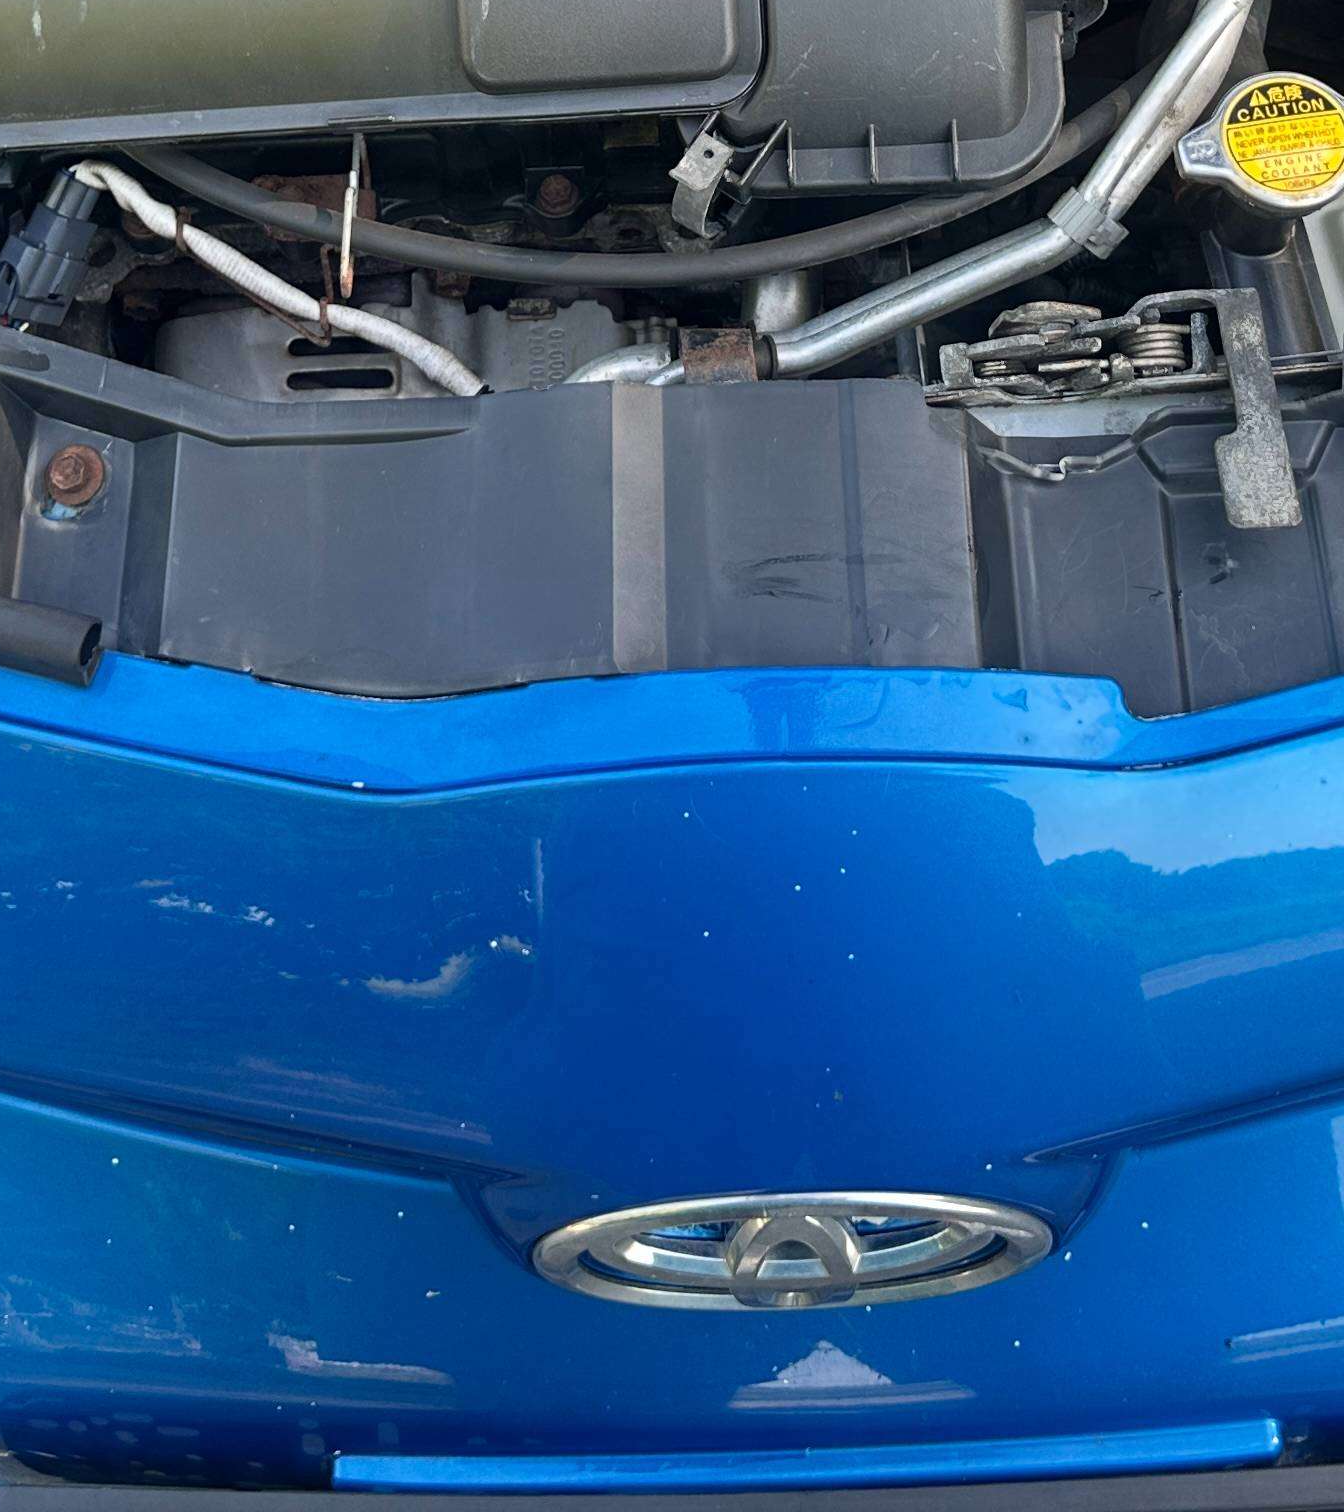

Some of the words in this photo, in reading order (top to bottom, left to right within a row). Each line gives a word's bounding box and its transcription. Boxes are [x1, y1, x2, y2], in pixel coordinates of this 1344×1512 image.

[1236, 97, 1324, 122] CAUTION
[1235, 137, 1264, 149] NEVER
[1266, 133, 1291, 144] OPEN
[1263, 151, 1324, 168] ENGINE
[1260, 162, 1331, 180] COOLANT
